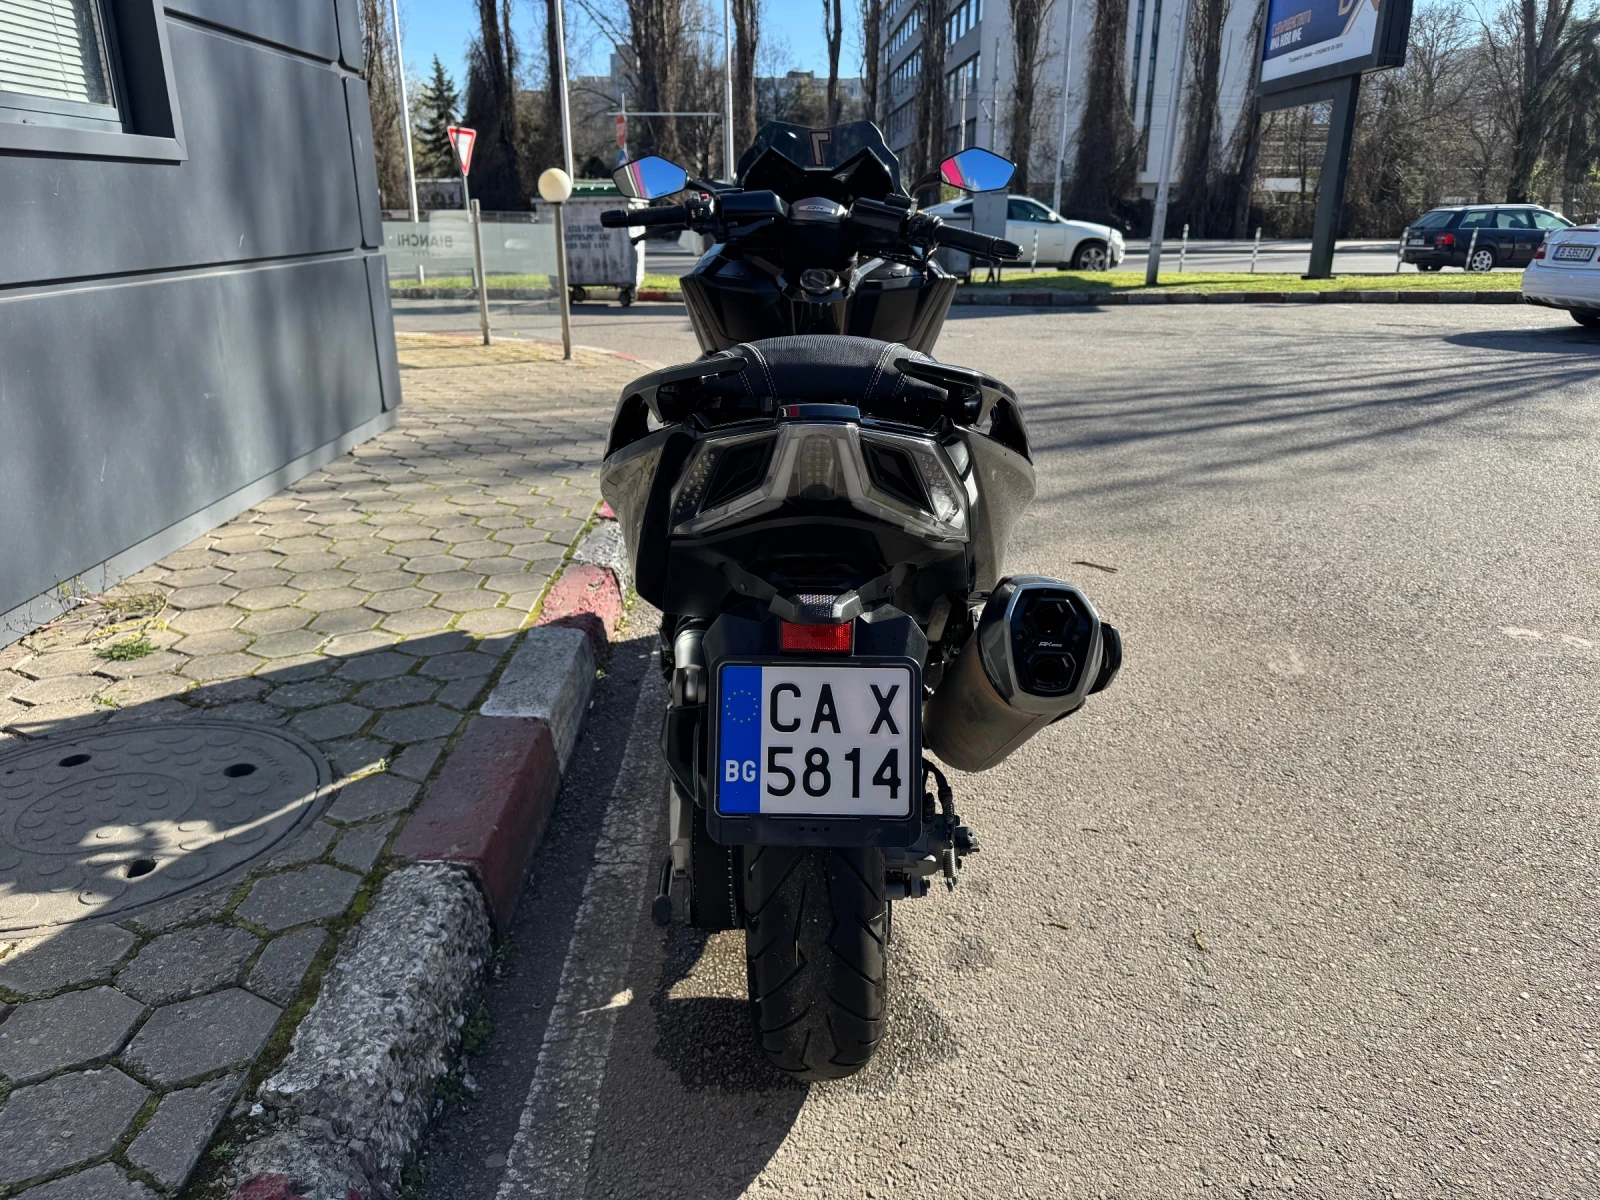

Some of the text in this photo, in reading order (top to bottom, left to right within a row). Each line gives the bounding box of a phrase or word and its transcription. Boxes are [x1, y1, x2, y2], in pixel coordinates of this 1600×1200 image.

[769, 682, 900, 735] CA X
[725, 759, 757, 783] BG
[766, 746, 902, 800] 5814
